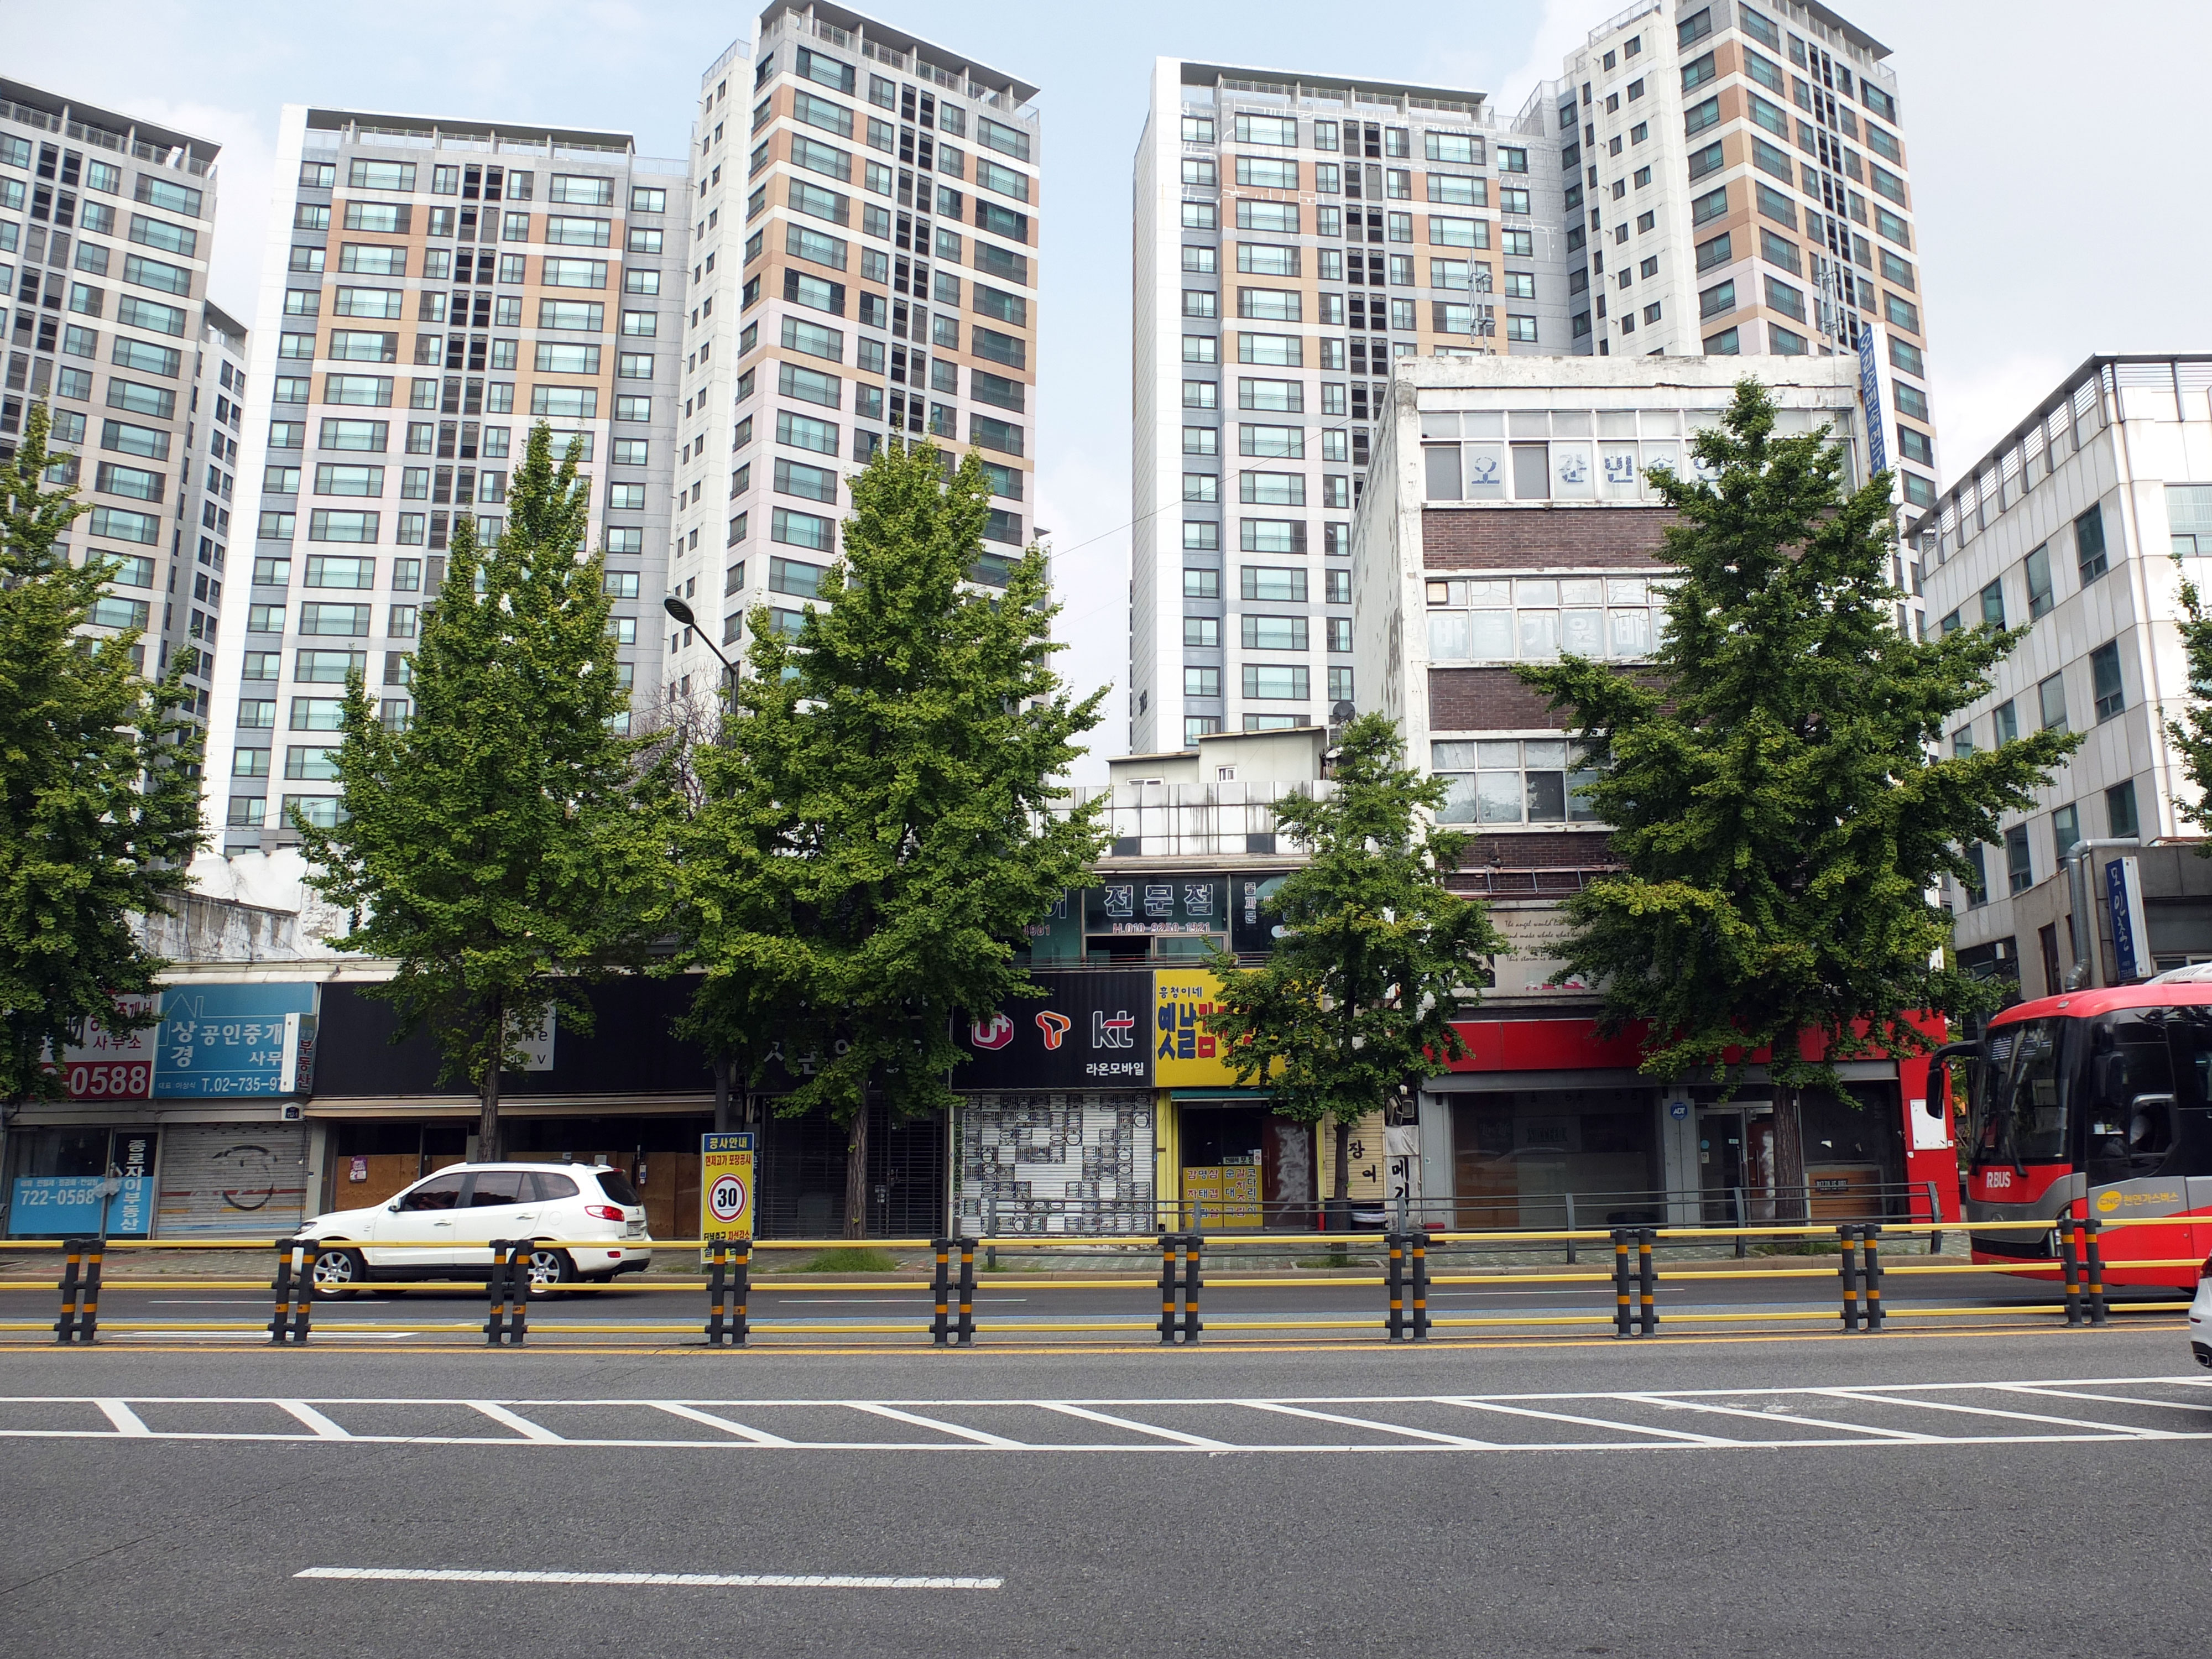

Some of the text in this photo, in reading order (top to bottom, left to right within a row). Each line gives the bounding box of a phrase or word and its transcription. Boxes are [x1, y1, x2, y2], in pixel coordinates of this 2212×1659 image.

[1104, 884, 1213, 917] 전문점
[1113, 922, 1211, 935] H.010-9250-1921
[1516, 920, 1531, 929] angel
[1159, 987, 1203, 998] 흥청이네
[1092, 1010, 1135, 1048] kt
[296, 1040, 312, 1089] 부동산
[1086, 1062, 1144, 1077] 라온모바일
[709, 1136, 748, 1150] 공사안내
[120, 1139, 147, 1231] 종로자이부동산
[1986, 1171, 2011, 1188] RBUS
[717, 1187, 738, 1208] 30
